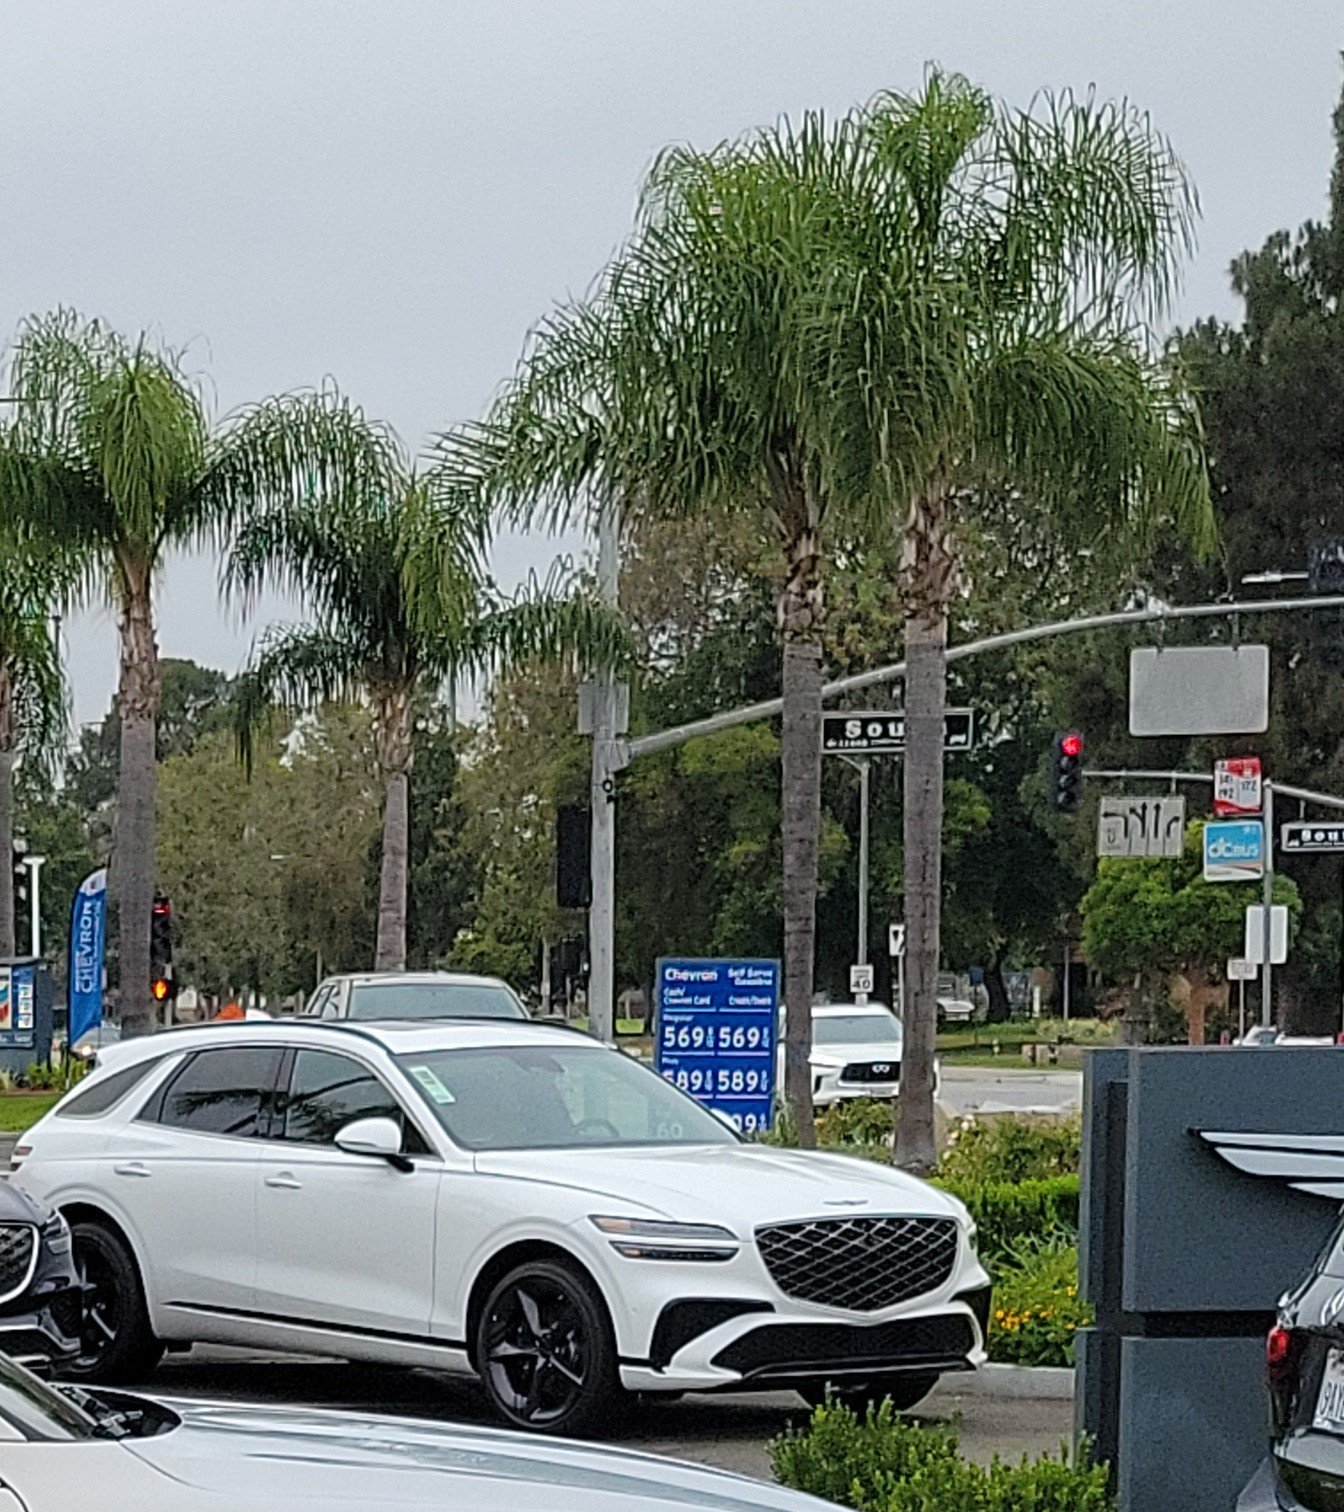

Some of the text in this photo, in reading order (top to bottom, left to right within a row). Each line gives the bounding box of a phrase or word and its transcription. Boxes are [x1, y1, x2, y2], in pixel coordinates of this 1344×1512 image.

[80, 900, 93, 994] CHEVRON
[664, 967, 718, 981] Chevron
[851, 979, 871, 990] 40
[663, 1026, 704, 1048] 569
[718, 1026, 760, 1049] 569
[717, 1069, 759, 1092] 589
